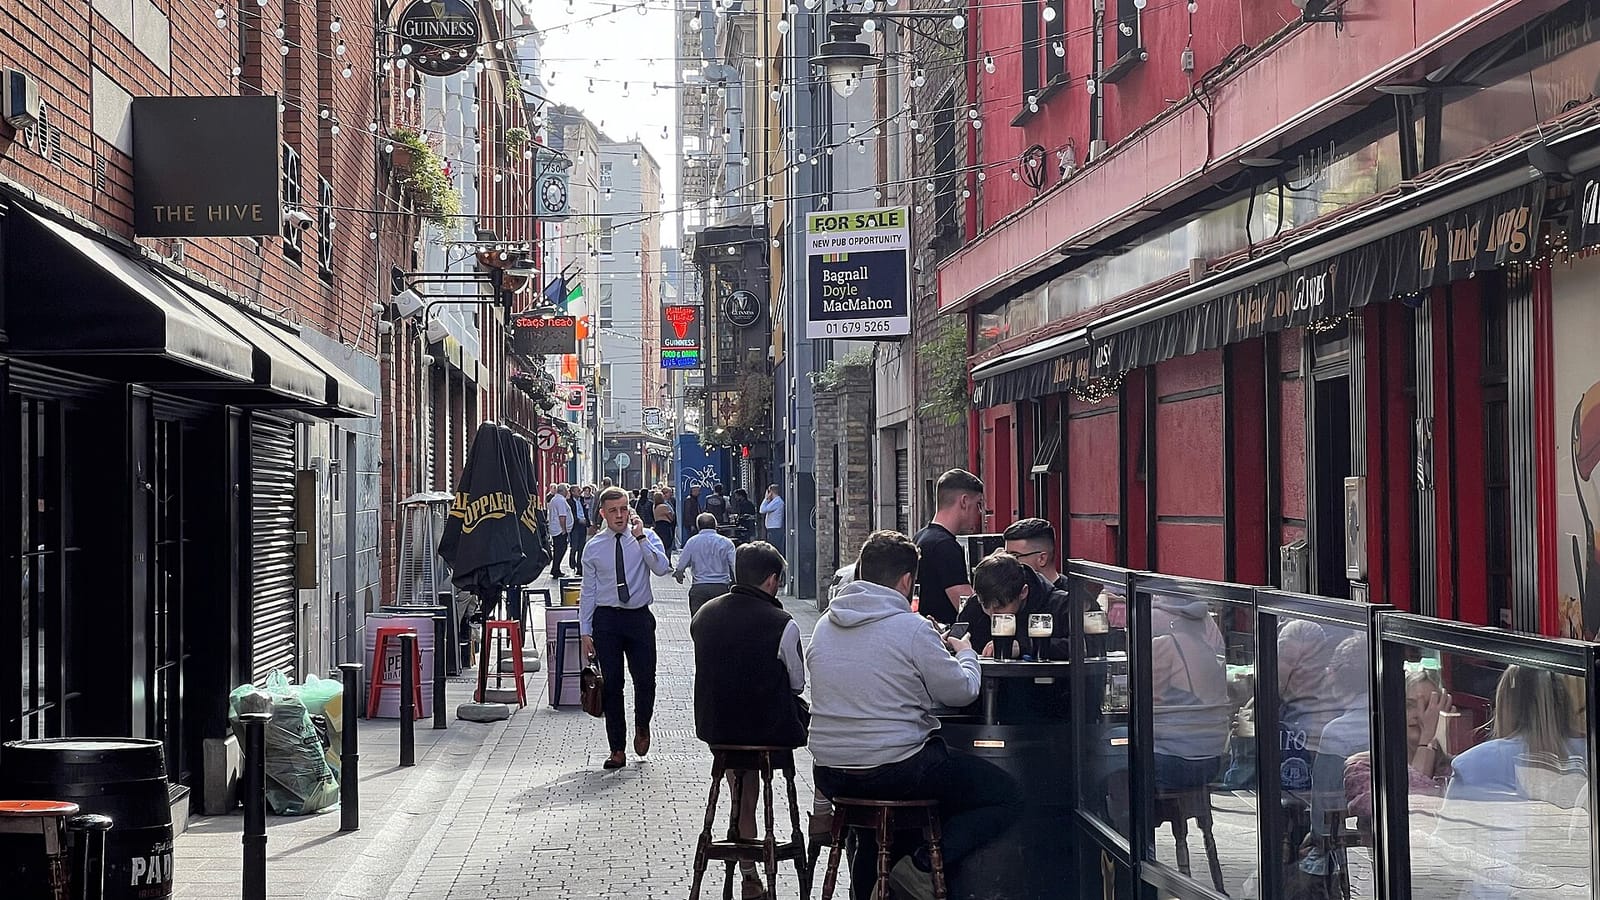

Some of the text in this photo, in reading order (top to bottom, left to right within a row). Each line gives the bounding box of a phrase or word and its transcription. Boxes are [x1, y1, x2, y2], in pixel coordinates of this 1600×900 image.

[404, 20, 475, 37] GUINNESS
[153, 204, 263, 222] THE HIVE
[815, 213, 899, 231] FOR SALE
[812, 235, 902, 248] NEW PUB OPPORTUNITY
[822, 266, 868, 284] Bagnall
[823, 283, 858, 300] Doyle
[823, 297, 893, 312] MacMahon
[826, 321, 890, 334] 01 679 5265
